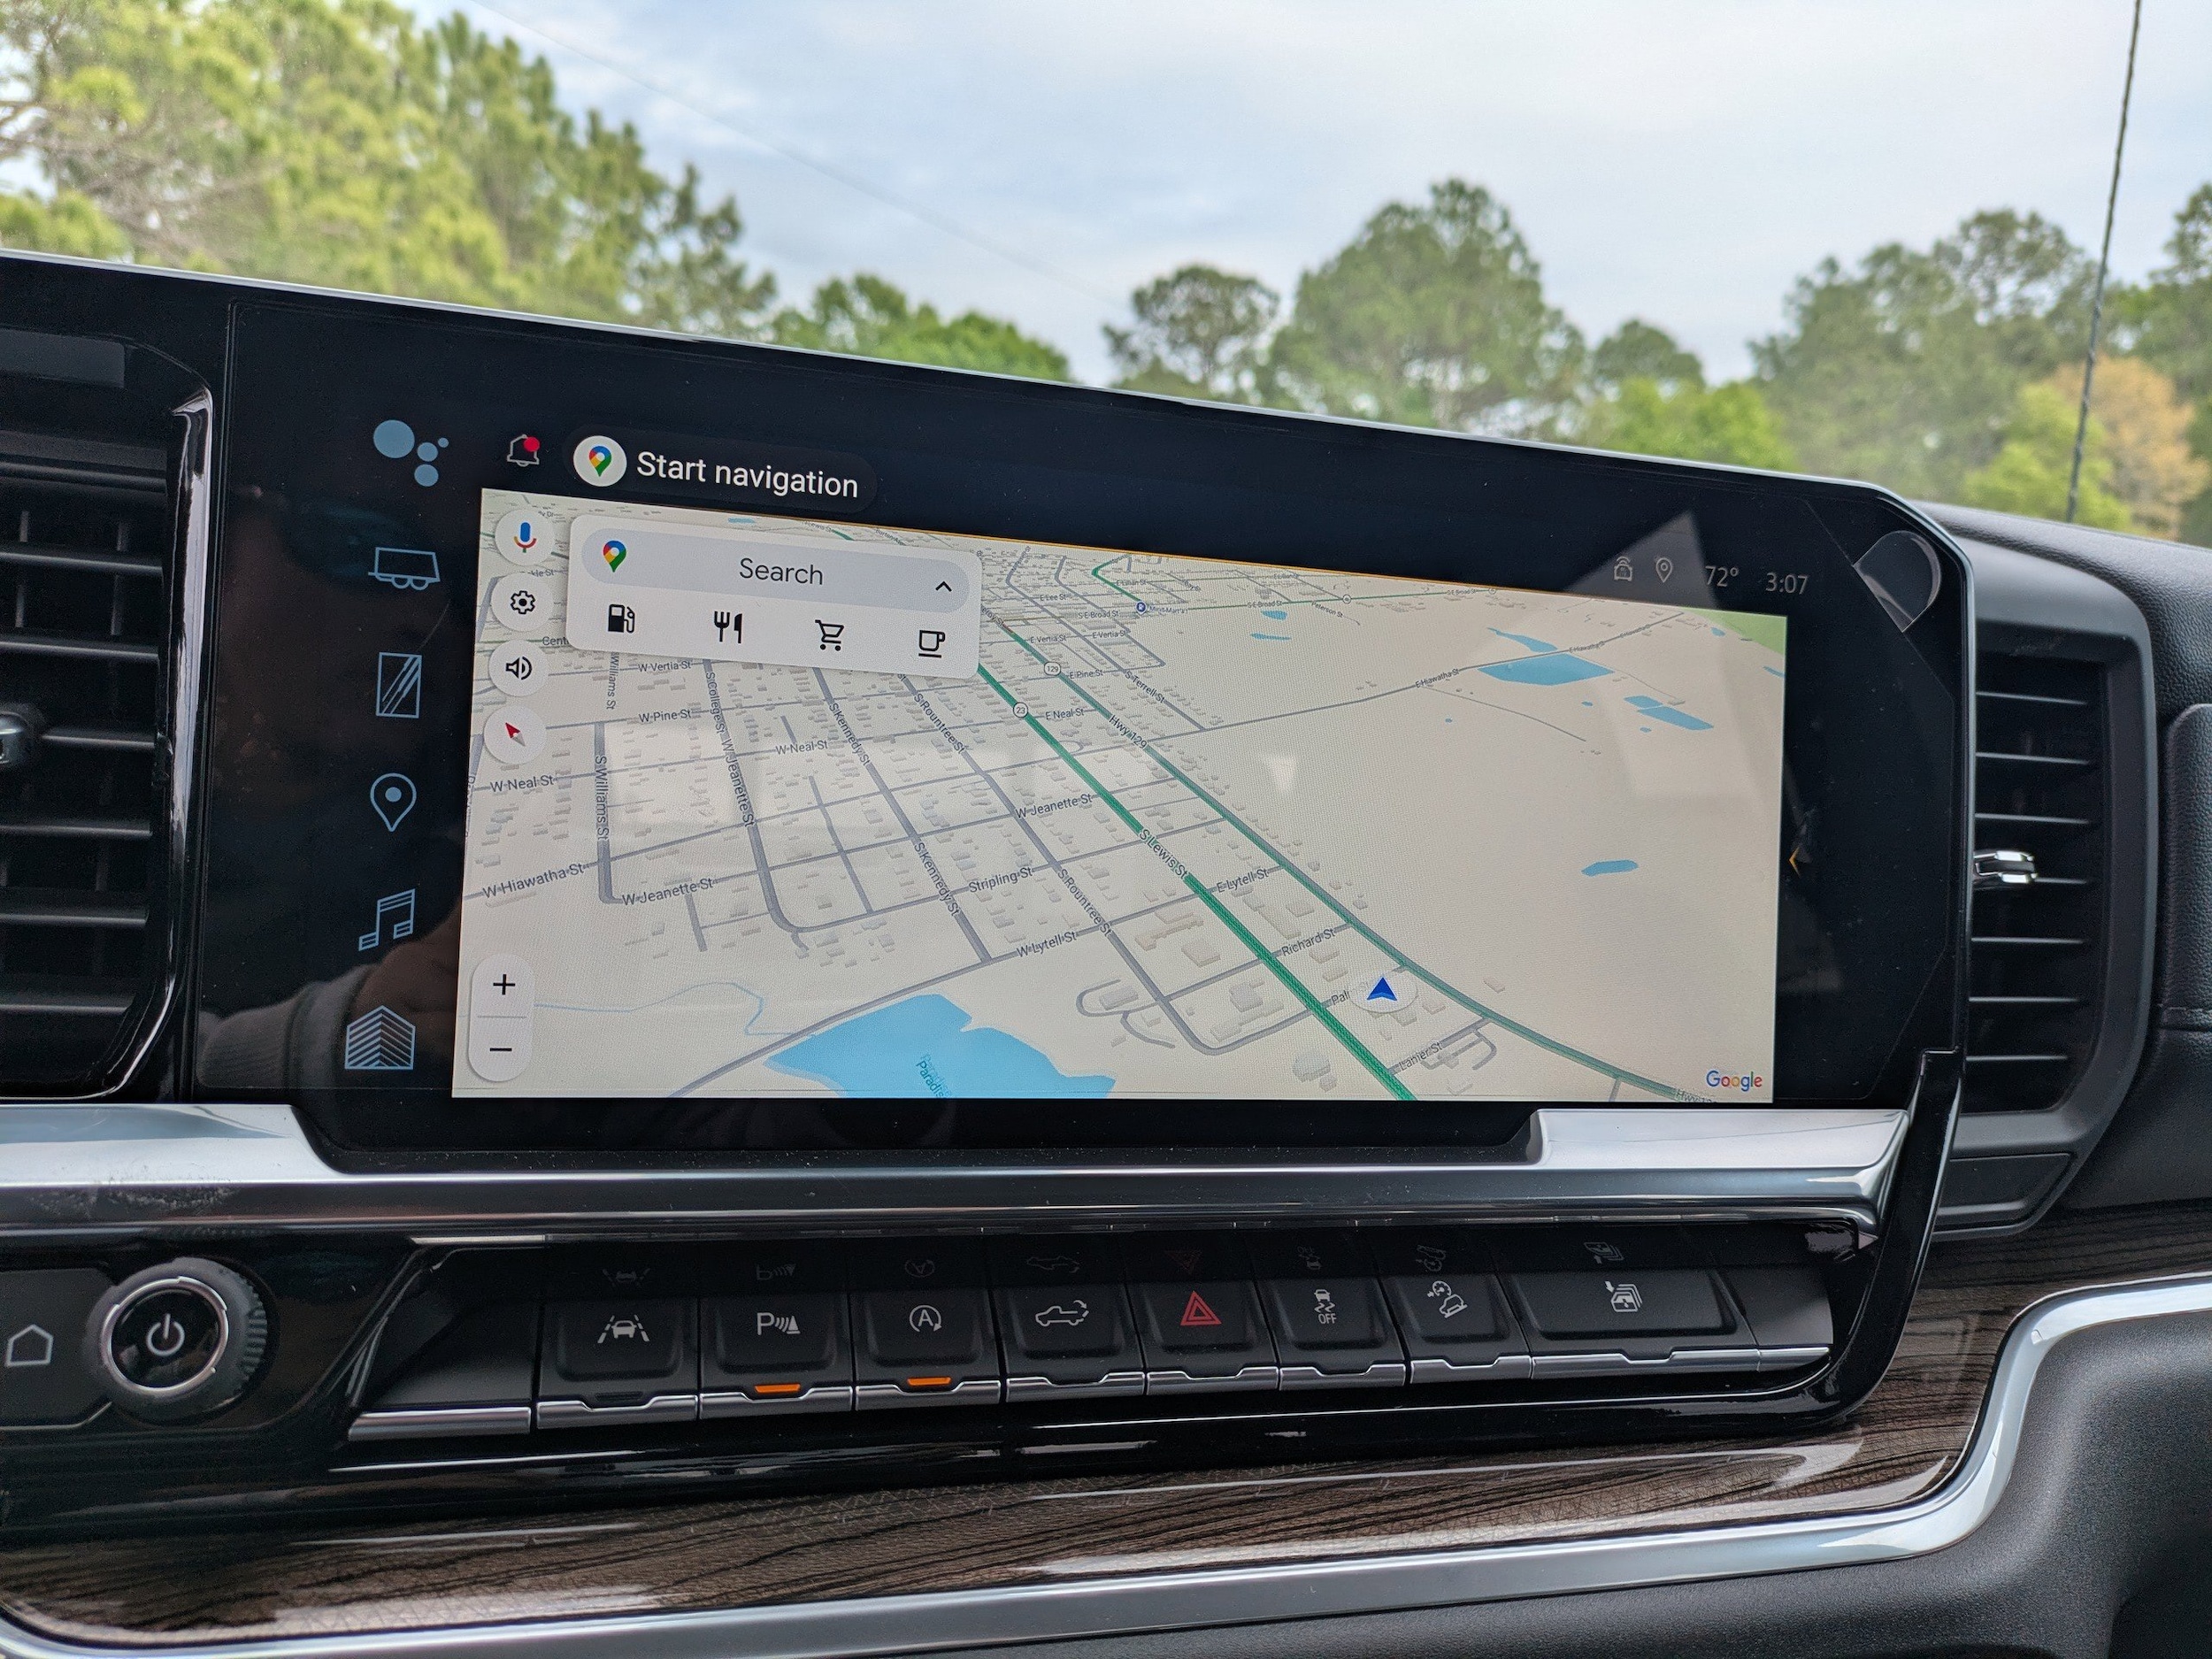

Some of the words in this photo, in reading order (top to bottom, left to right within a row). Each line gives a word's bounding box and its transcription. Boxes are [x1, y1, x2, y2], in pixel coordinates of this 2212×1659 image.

[636, 451, 706, 482] Start
[715, 464, 858, 498] navigation
[739, 557, 824, 586] Search
[1765, 572, 1809, 595] 3:07
[1110, 609, 1120, 618] St
[1058, 634, 1067, 642] St
[638, 664, 648, 672] W
[651, 661, 680, 672] Vertia
[680, 660, 692, 670] St
[1047, 664, 1060, 673] 129
[608, 655, 619, 697] Williams
[706, 672, 716, 680] S
[1076, 670, 1094, 679] Pine
[1422, 670, 1452, 686] Hiawatha
[1125, 671, 1132, 680] S
[1131, 676, 1156, 698] Terrell
[1156, 693, 1166, 704] St
[606, 700, 617, 710] St
[708, 682, 724, 723] College
[914, 693, 924, 703] S
[829, 703, 839, 712] S
[1017, 706, 1026, 715] 23
[1046, 710, 1052, 720] E
[1053, 709, 1073, 719] Neal
[1075, 707, 1085, 717] St
[638, 712, 651, 723] W
[653, 710, 678, 722] Pine
[680, 709, 692, 719] St
[918, 700, 956, 744] Rountree
[715, 722, 726, 734] St
[833, 711, 863, 755] Kennedy
[1109, 714, 1133, 737] Hwy
[1129, 731, 1148, 749] 129
[721, 738, 735, 752] W
[775, 745, 788, 756] W
[789, 741, 815, 754] Neal
[817, 740, 828, 750] St
[954, 741, 965, 754] St
[595, 755, 607, 765] S
[859, 753, 872, 766] St
[490, 780, 505, 793] W
[508, 776, 538, 791] Neal
[540, 774, 554, 787] St
[726, 756, 753, 814] Jeanette
[595, 766, 609, 826] Williams
[1015, 808, 1027, 818] W
[1031, 797, 1079, 817] Jeanette
[1080, 794, 1093, 805] St
[741, 812, 755, 827] St
[597, 826, 610, 841] St
[914, 841, 926, 852] S
[1139, 829, 1151, 841] S
[1146, 835, 1177, 871] Lewis
[1173, 864, 1188, 880] St
[482, 887, 497, 899] W
[500, 869, 567, 895] Hiawatha
[569, 862, 585, 875] St
[919, 850, 953, 902] Kennedy
[969, 871, 1018, 893] Stripling
[1019, 866, 1033, 879] St
[1057, 868, 1069, 880] S
[1217, 881, 1225, 894] E
[1225, 872, 1256, 892] Lytell
[1256, 868, 1270, 880] St
[622, 893, 635, 906] W
[639, 882, 698, 903] Jeanette
[700, 877, 713, 890] St
[947, 901, 960, 917] St
[1061, 877, 1102, 925] Rountree
[1099, 922, 1112, 937] St
[1017, 946, 1029, 958] W
[1031, 934, 1063, 956] Lytell
[1064, 931, 1078, 943] St
[1281, 933, 1322, 957] Richard
[1322, 928, 1336, 941] St
[1431, 1041, 1443, 1055] St
[1706, 1070, 1763, 1092] Google
[1318, 1313, 1337, 1325] OFF
